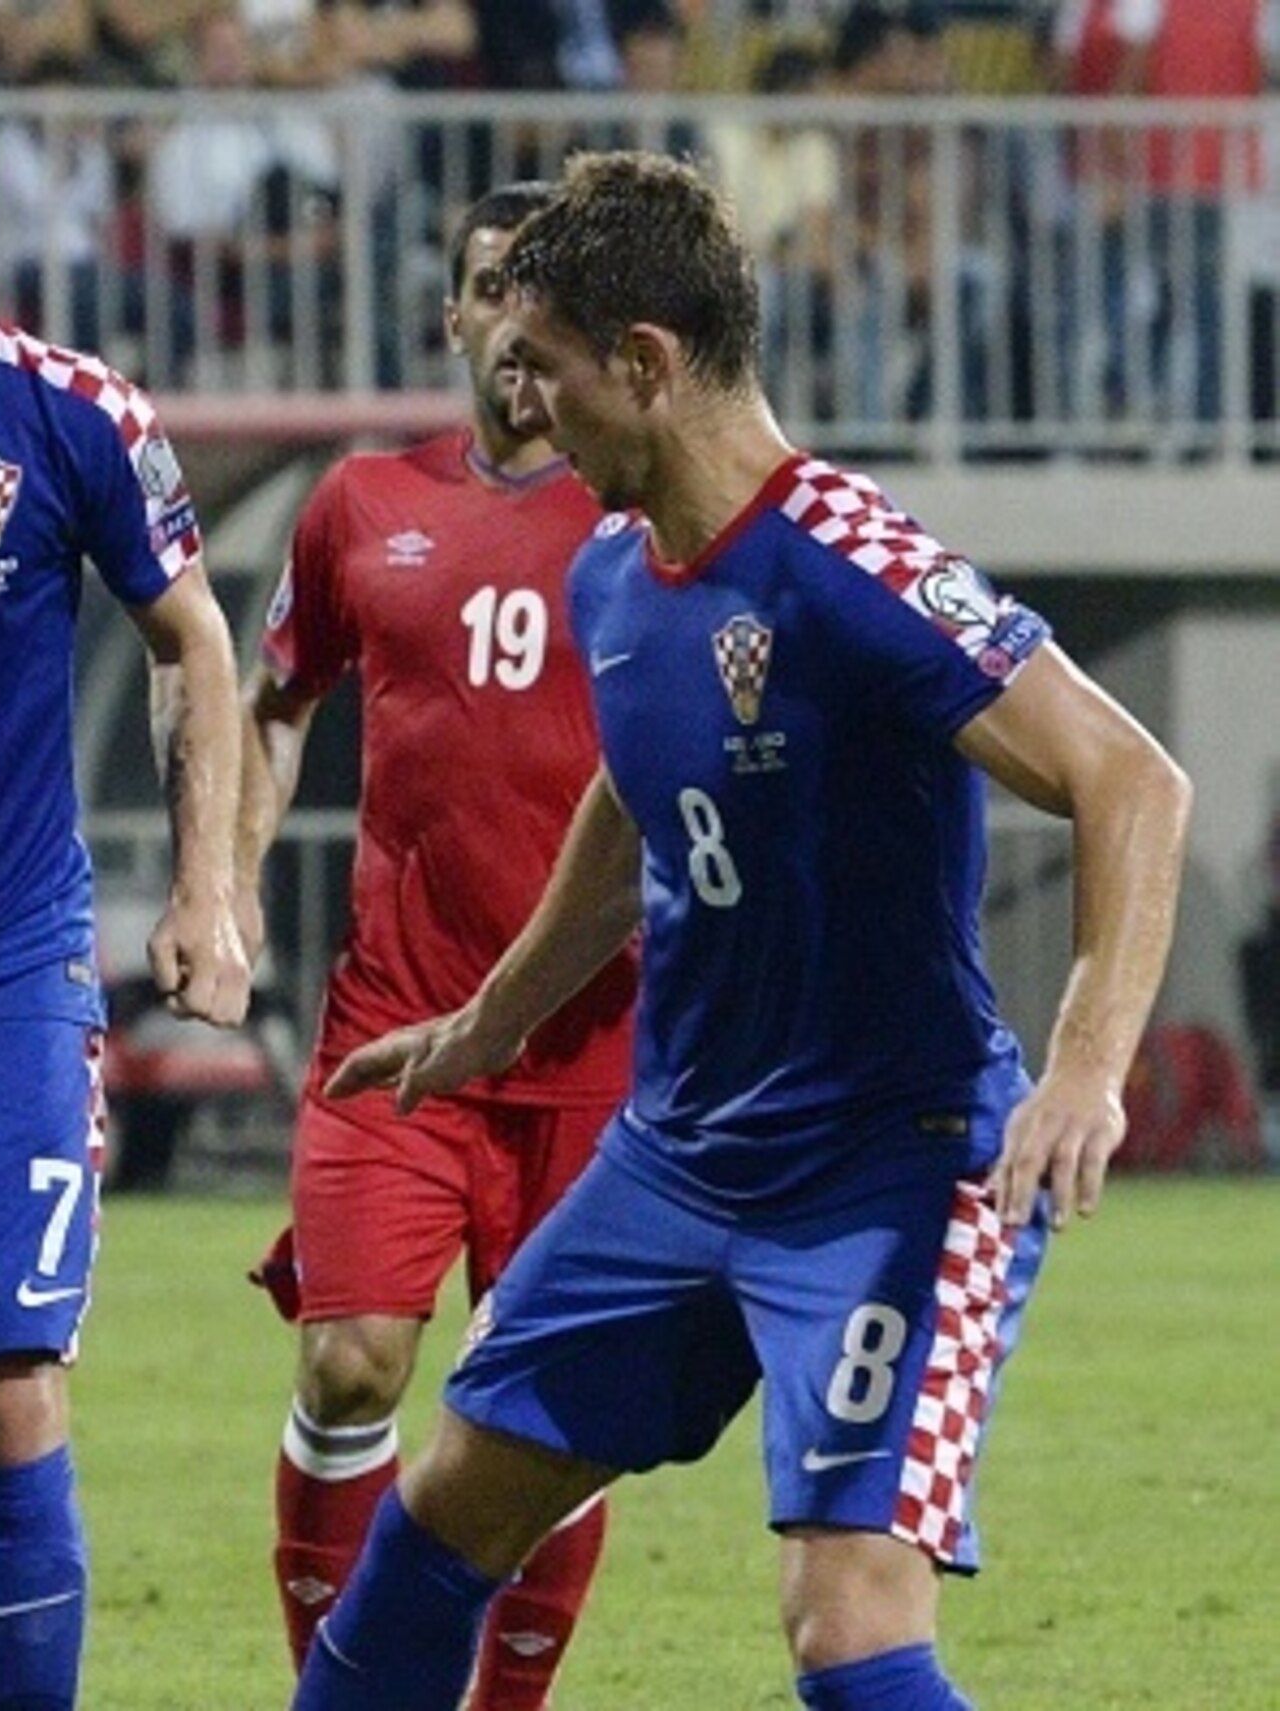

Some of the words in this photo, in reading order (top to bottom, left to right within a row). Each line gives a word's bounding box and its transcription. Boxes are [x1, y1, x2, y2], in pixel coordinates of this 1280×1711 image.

[460, 585, 549, 691] 19
[678, 787, 742, 907] 8
[29, 1158, 84, 1277] 7
[825, 1303, 907, 1423] 8
